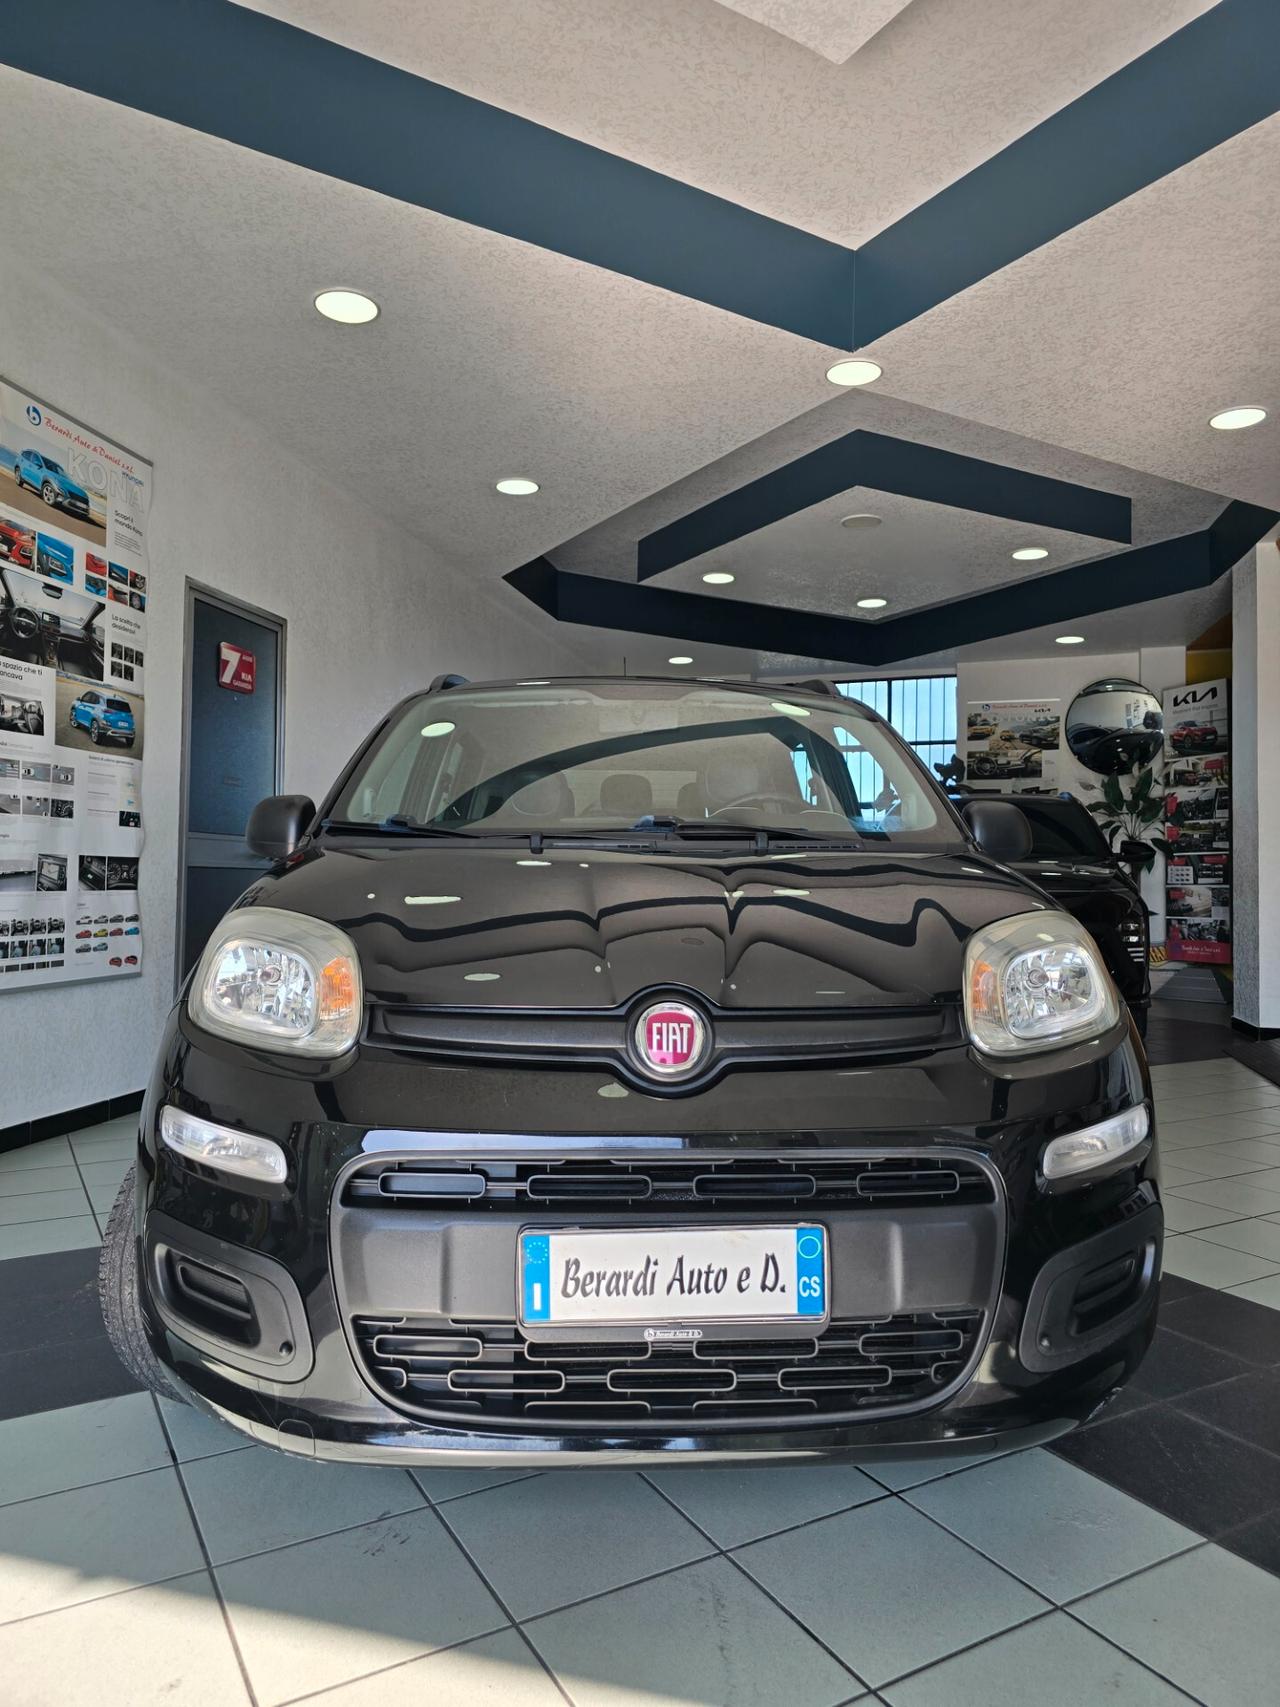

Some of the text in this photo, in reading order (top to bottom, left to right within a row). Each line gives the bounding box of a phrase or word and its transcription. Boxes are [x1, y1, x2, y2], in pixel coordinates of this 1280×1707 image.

[68, 447, 145, 513] KONA
[2, 661, 23, 671] spazio
[24, 665, 36, 674] che
[222, 647, 242, 684] 7
[1173, 686, 1217, 707] KIA
[652, 1022, 691, 1054] FIAT
[561, 1252, 786, 1299] Berardi Auto e D.
[799, 1276, 821, 1298] CS
